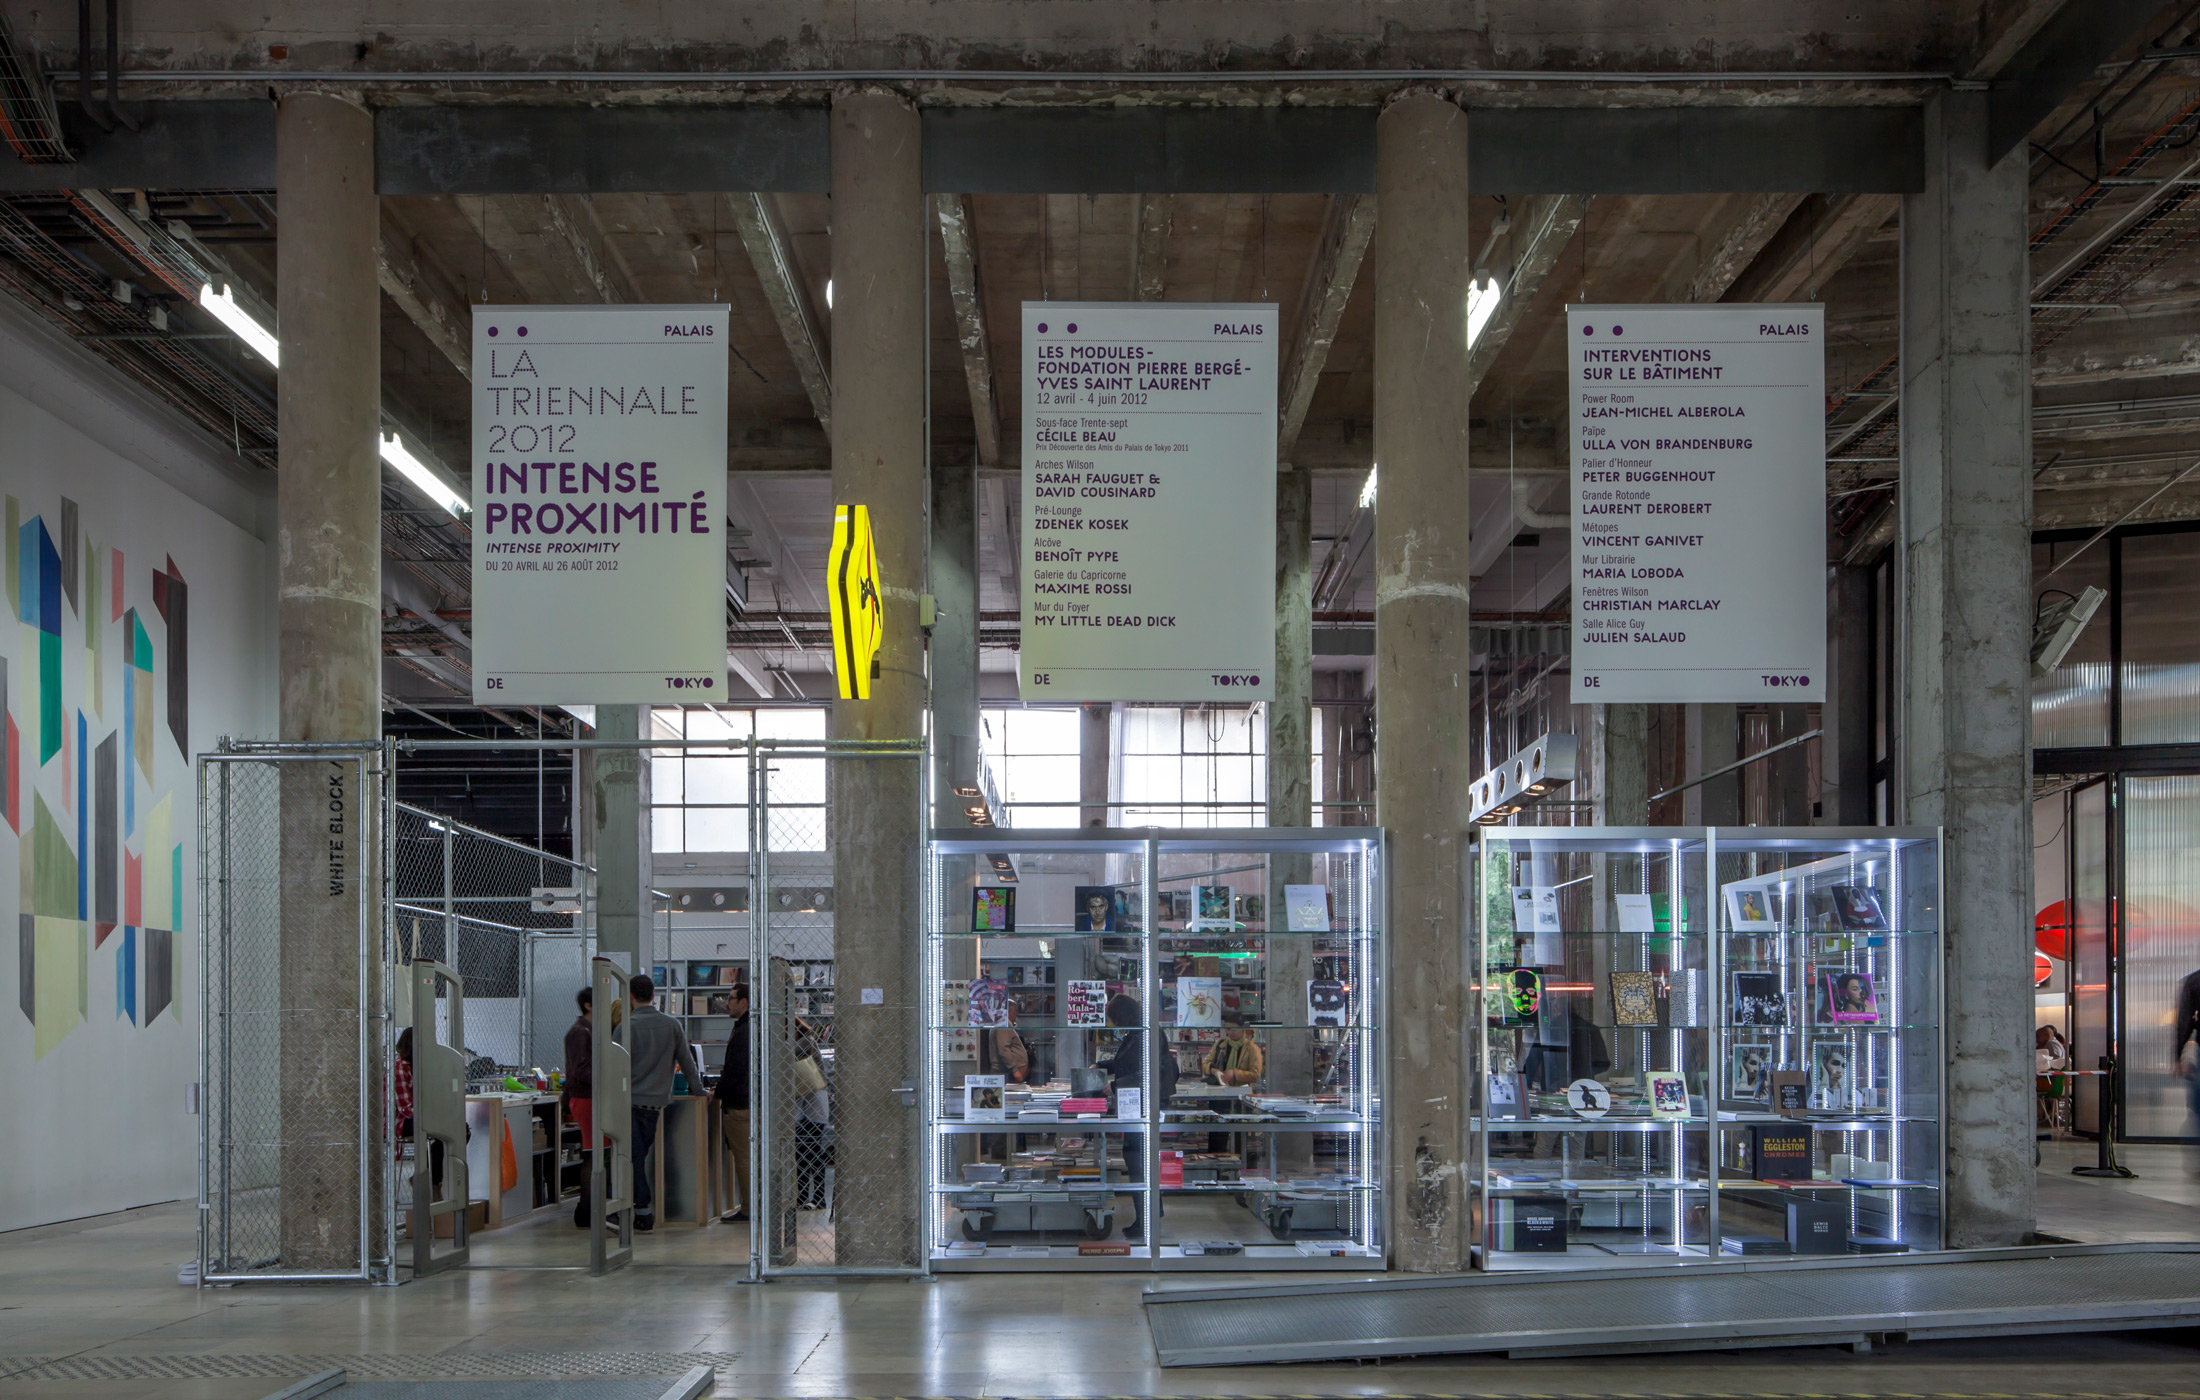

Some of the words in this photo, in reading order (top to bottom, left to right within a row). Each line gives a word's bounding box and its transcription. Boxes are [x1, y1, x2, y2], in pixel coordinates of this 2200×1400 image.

[665, 325, 713, 336] PALAIS
[1214, 324, 1263, 335] PALAIS
[1760, 325, 1808, 335] PALAIS
[1039, 346, 1063, 358] LES
[1584, 350, 1711, 362] INTERVENTIONS
[492, 350, 538, 378] LA
[1039, 362, 1129, 374] FONDATION
[1138, 362, 1187, 375] PIERRE
[1584, 368, 1612, 380] SUR
[1620, 368, 1636, 380] LE
[1643, 363, 1723, 379] BÂTIMENT
[1037, 377, 1078, 389] YVES
[1085, 378, 1133, 390] SAINT
[1140, 378, 1211, 390] LAURENT
[487, 386, 697, 415] TRIENNALE
[1038, 393, 1049, 404] 12
[1054, 393, 1075, 404] avril
[1088, 393, 1094, 404] 4
[1098, 393, 1116, 407] juin
[1121, 393, 1147, 404] 2012
[1583, 394, 1607, 403] Power
[1611, 394, 1634, 403] Room
[1583, 407, 1673, 418] JEAN-MICHEL
[1678, 407, 1745, 417] ALBEROLA
[1036, 418, 1077, 428] Sous-face
[1081, 418, 1128, 429] Trente-sept
[1037, 429, 1077, 442] CÉCILE
[1083, 432, 1115, 442] BEAU
[1583, 426, 1605, 437] Païpe
[489, 425, 575, 453] 2012
[1583, 440, 1616, 450] ULLA
[1620, 440, 1649, 449] VON
[1656, 439, 1752, 449] BRANDENBURG
[1154, 444, 1171, 452] Tokyo
[1035, 460, 1063, 469] Arches
[1067, 460, 1093, 469] Wilson
[1583, 458, 1606, 468] Palier
[1609, 458, 1652, 467] d'Honneur
[487, 462, 659, 494] INTENSE
[1036, 473, 1080, 483] SARAH
[1087, 474, 1144, 484] FAUGUET
[1583, 472, 1620, 482] PETER
[1626, 471, 1715, 482] BUGGENHOUT
[1036, 487, 1075, 497] DAVID
[1081, 487, 1155, 497] COUSINARD
[1582, 491, 1612, 500] Grande
[1616, 490, 1650, 500] Rotonde
[486, 490, 710, 534] PROXIMITÉ
[1035, 505, 1081, 517] Pré-Lounge
[1583, 504, 1642, 514] LAURENT
[1648, 503, 1712, 514] DEROBERT
[1035, 519, 1083, 529] ZDENEK
[1089, 520, 1128, 530] KOSEK
[1583, 523, 1618, 534] Métopes
[1034, 538, 1061, 547] Alcôve
[1582, 536, 1640, 546] VINCENT
[1645, 536, 1703, 546] GANIVET
[487, 543, 541, 553] INTENSE
[547, 543, 620, 553] PROXIMITY
[1036, 548, 1082, 561] BENOÎT
[1088, 552, 1118, 562] PYPE
[1583, 555, 1598, 564] Mur
[1602, 555, 1635, 564] Librairie
[486, 561, 498, 571] DU
[502, 561, 513, 571] 20
[516, 561, 539, 571] AVRIL
[543, 562, 553, 571] AU
[557, 561, 568, 571] 26
[571, 559, 593, 570] AOÛT
[597, 561, 618, 570] 2012
[1034, 570, 1064, 579] Galerie
[1067, 570, 1077, 579] du
[1081, 570, 1126, 581] Capricorne
[1583, 568, 1626, 578] MARIA
[1632, 568, 1684, 578] LOBODA
[1035, 583, 1089, 594] MAXIME
[1096, 584, 1131, 594] ROSSI
[1583, 587, 1618, 596] Fenêtres
[1621, 587, 1648, 596] Wilson
[1035, 602, 1050, 611] Mur
[1054, 602, 1063, 611] du
[1068, 602, 1089, 613] Foyer
[1583, 600, 1651, 610] CHRISTIAN
[1658, 600, 1720, 610] MARCLAY
[1035, 616, 1055, 625] MY
[1061, 616, 1101, 626] LITTLE
[1107, 616, 1141, 626] DEAD
[1148, 616, 1175, 626] DICK
[1583, 619, 1603, 628] Salle
[1607, 619, 1626, 628] Alice
[1630, 619, 1645, 630] Guy
[1583, 632, 1628, 643] JULIEN
[1634, 632, 1686, 642] SALAUD
[487, 678, 503, 689] DE
[665, 677, 713, 688] TOKYO
[1035, 674, 1050, 685] DE
[1212, 675, 1260, 686] TOKYO
[1584, 677, 1600, 687] DE
[1762, 676, 1810, 686] TOKYO
[329, 775, 344, 834] BLOCK
[329, 840, 344, 896] WHITE
[1068, 985, 1085, 994] Ro-
[1068, 994, 1086, 1002] bert
[1068, 1003, 1094, 1012] Mala-
[1068, 1011, 1080, 1020] val
[1763, 1143, 1806, 1151] EGGLESTON
